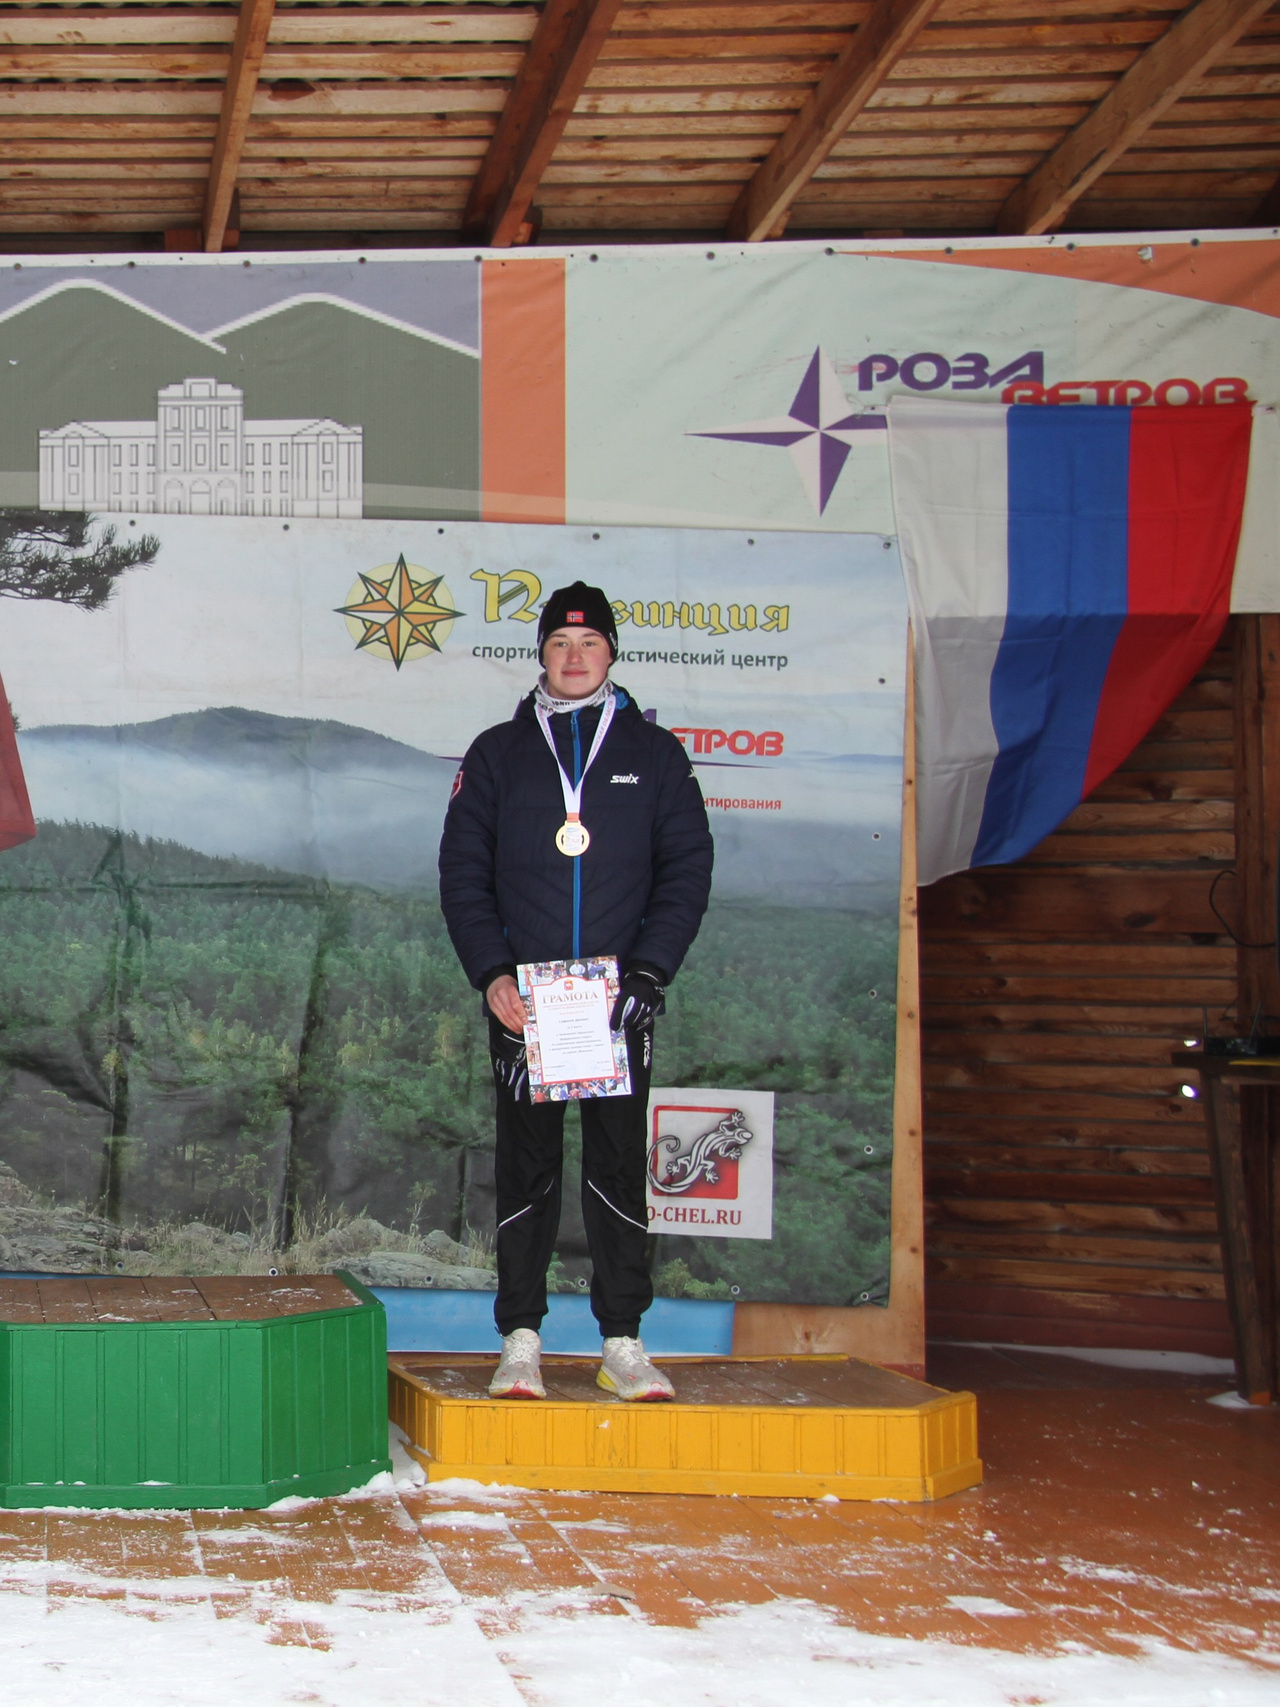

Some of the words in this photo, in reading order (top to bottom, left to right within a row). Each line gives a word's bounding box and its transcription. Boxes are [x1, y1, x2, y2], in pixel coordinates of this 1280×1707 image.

[858, 350, 1044, 392] РОЗА
[469, 568, 790, 636] Пвинция
[731, 653, 789, 671] центр
[542, 990, 599, 1004] ГРАМОТА
[646, 1205, 742, 1226] O-CHEL.RU
